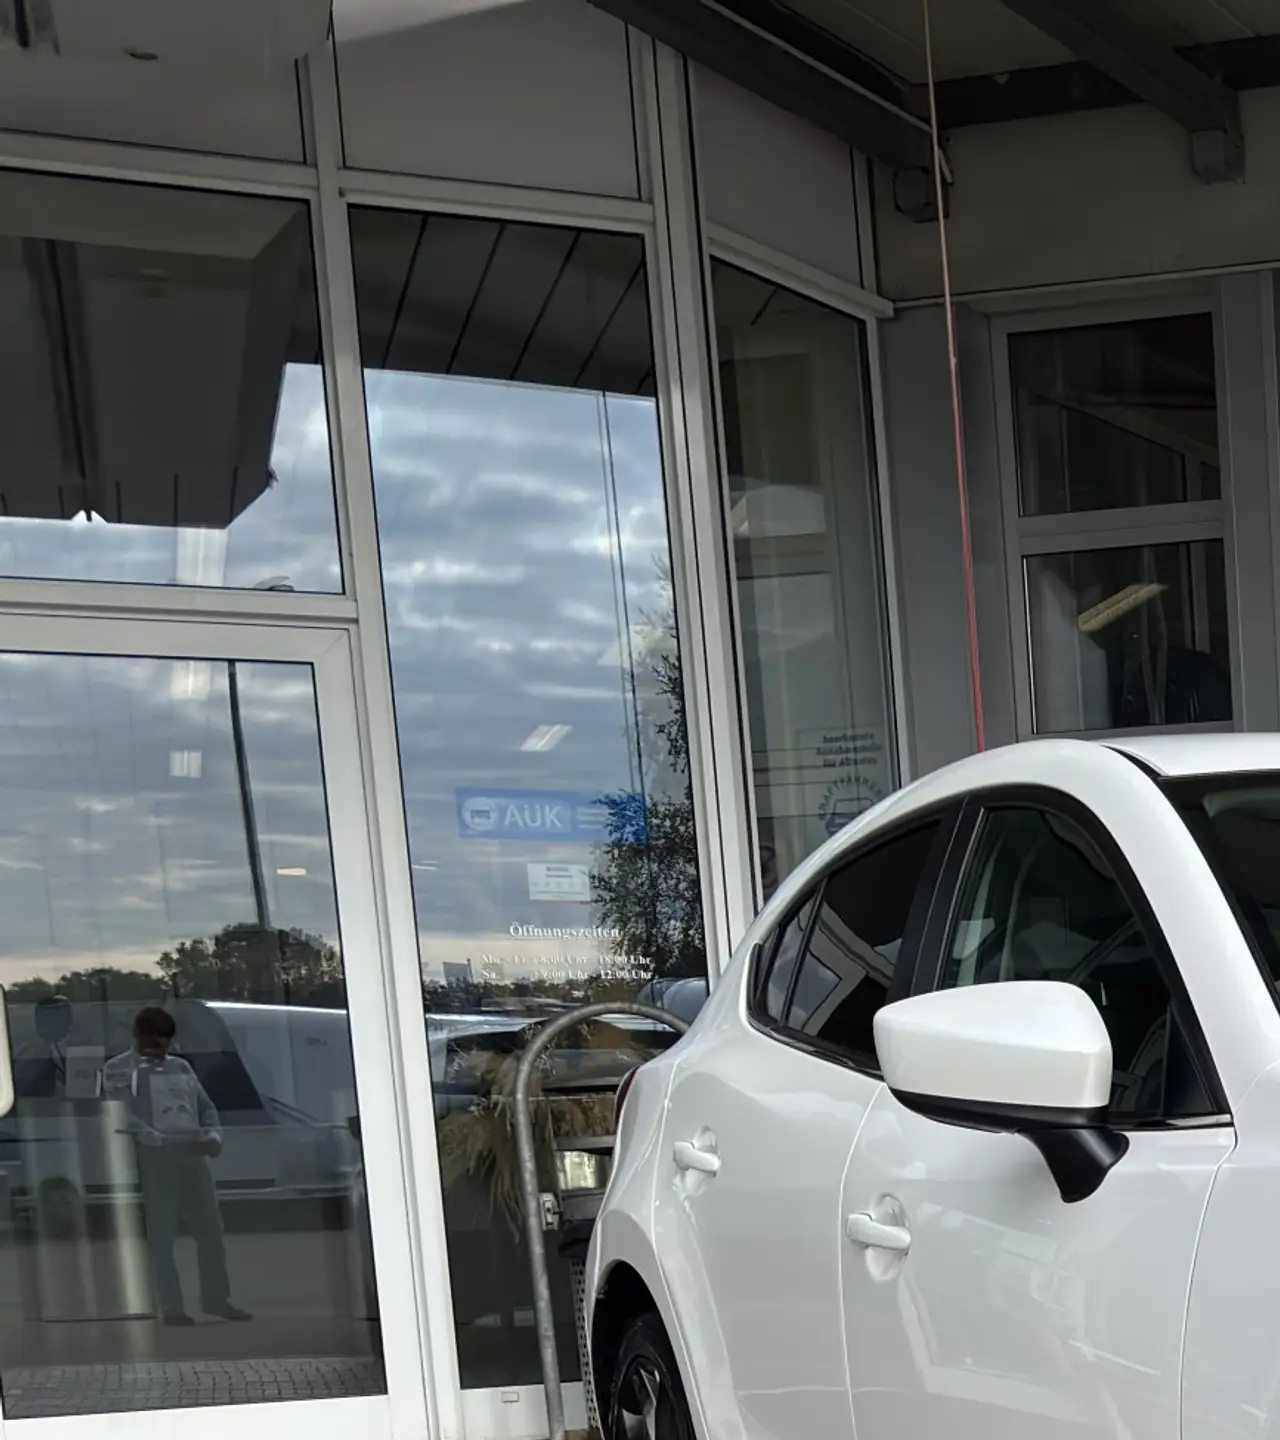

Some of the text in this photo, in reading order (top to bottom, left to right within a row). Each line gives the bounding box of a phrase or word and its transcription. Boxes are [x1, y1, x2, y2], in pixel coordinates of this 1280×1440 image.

[504, 804, 562, 829] AÜK
[509, 921, 619, 940] Öffnungszeiten
[630, 954, 652, 965] Uhr
[568, 969, 588, 980] Uhr
[631, 969, 653, 980] Uhr
